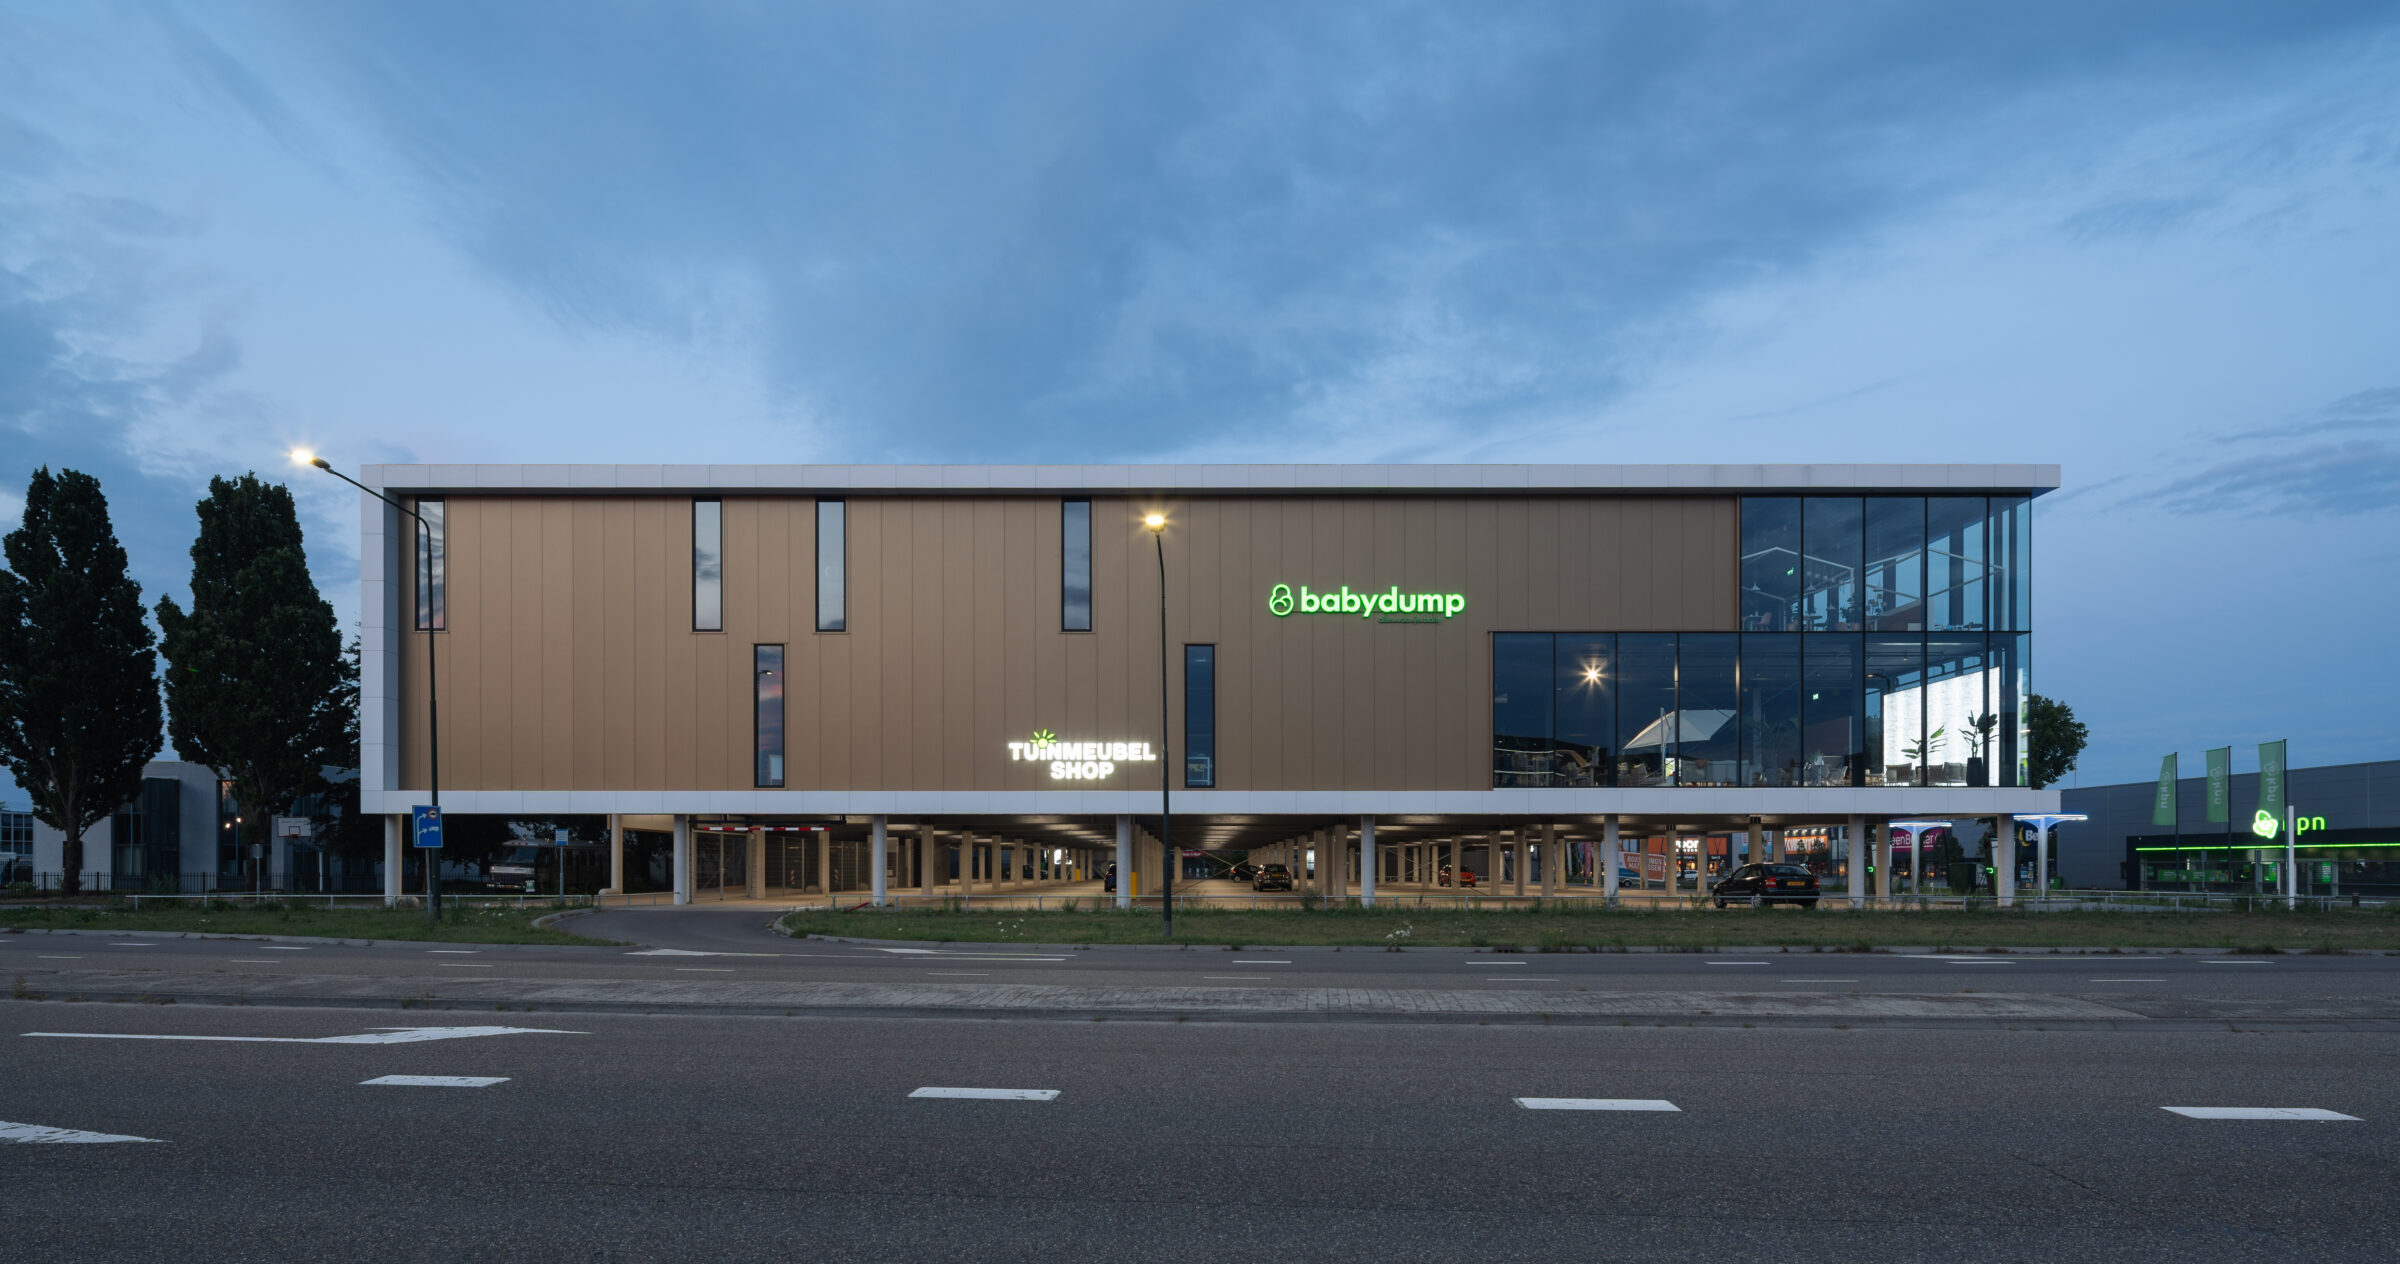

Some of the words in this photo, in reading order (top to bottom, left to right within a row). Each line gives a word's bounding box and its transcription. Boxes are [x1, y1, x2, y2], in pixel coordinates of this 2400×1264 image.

[1301, 586, 1465, 618] babydump
[1008, 742, 1156, 761] TUINMEUBEL
[1050, 761, 1114, 779] SHOP
[2283, 816, 2325, 835] pn
